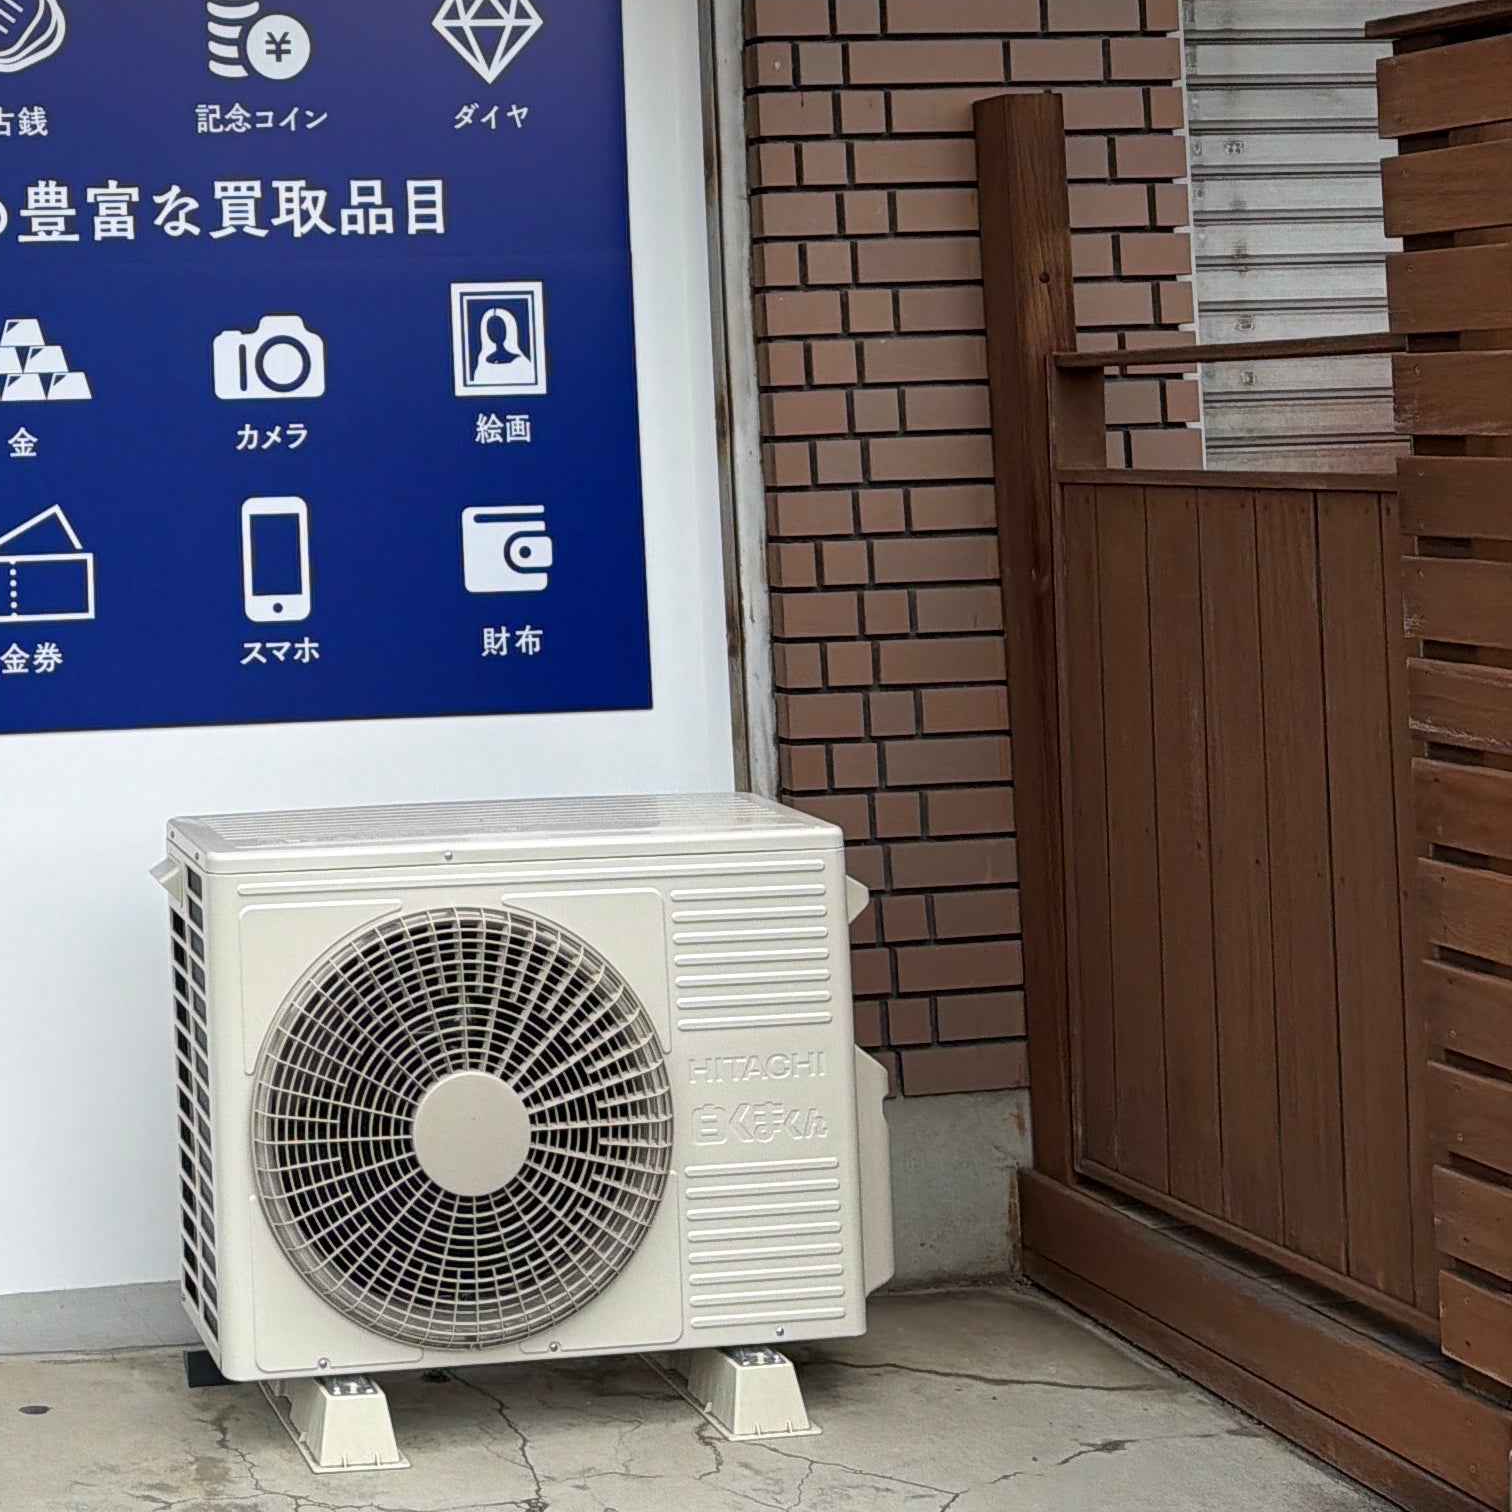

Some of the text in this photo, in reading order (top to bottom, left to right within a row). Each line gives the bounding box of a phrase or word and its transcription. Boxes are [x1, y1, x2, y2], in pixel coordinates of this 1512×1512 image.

[194, 102, 328, 134] 記念コイン
[454, 102, 529, 130] ダイヤ
[7, 426, 38, 458] 金
[236, 423, 308, 451] カメラ
[475, 413, 531, 444] 絵画
[240, 636, 320, 665] スマホ
[481, 624, 544, 657] 財布
[0, 641, 63, 674] 金券
[689, 1050, 826, 1084] HITACHI
